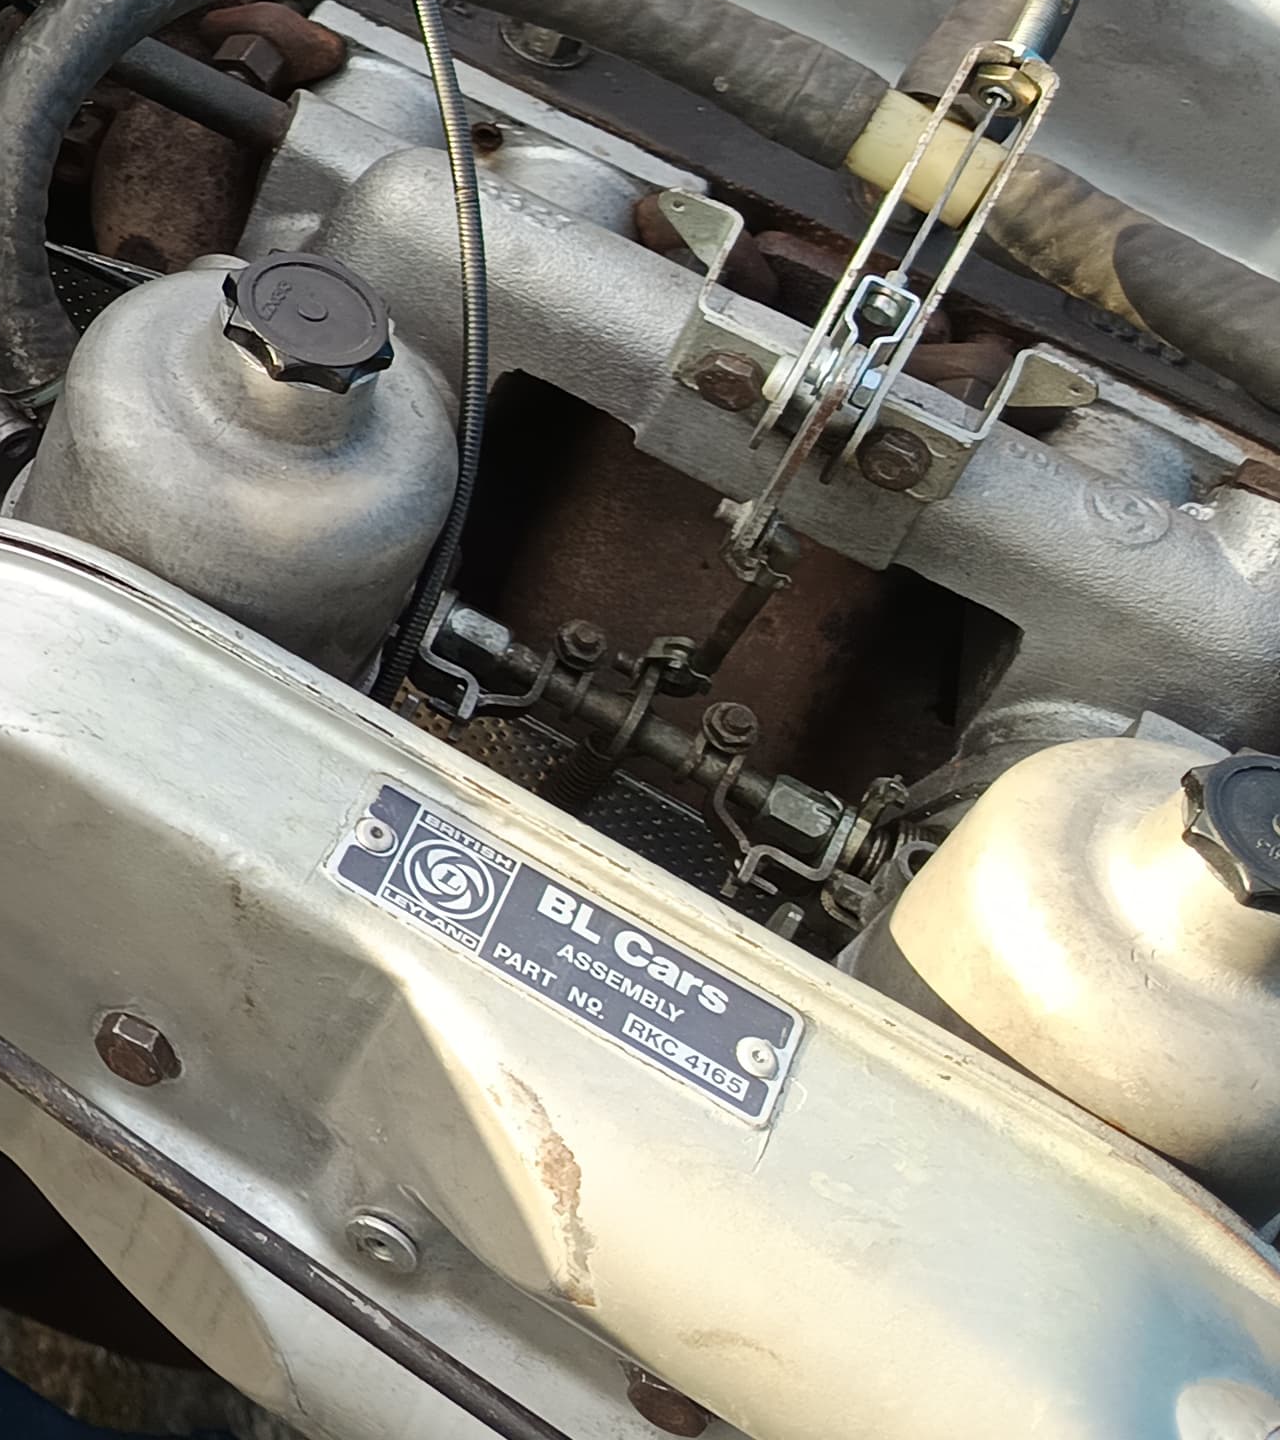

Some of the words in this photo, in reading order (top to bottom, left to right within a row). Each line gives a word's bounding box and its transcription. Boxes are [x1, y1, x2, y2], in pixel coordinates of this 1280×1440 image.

[424, 810, 514, 871] BRITISH
[382, 887, 481, 950] LEYLAND
[536, 883, 601, 945] BL
[613, 929, 729, 1015] Cars
[492, 942, 558, 988] PART
[627, 1021, 680, 1058] RKC
[683, 1054, 746, 1096] 4165
[556, 943, 686, 1024] ASSEMBLY
